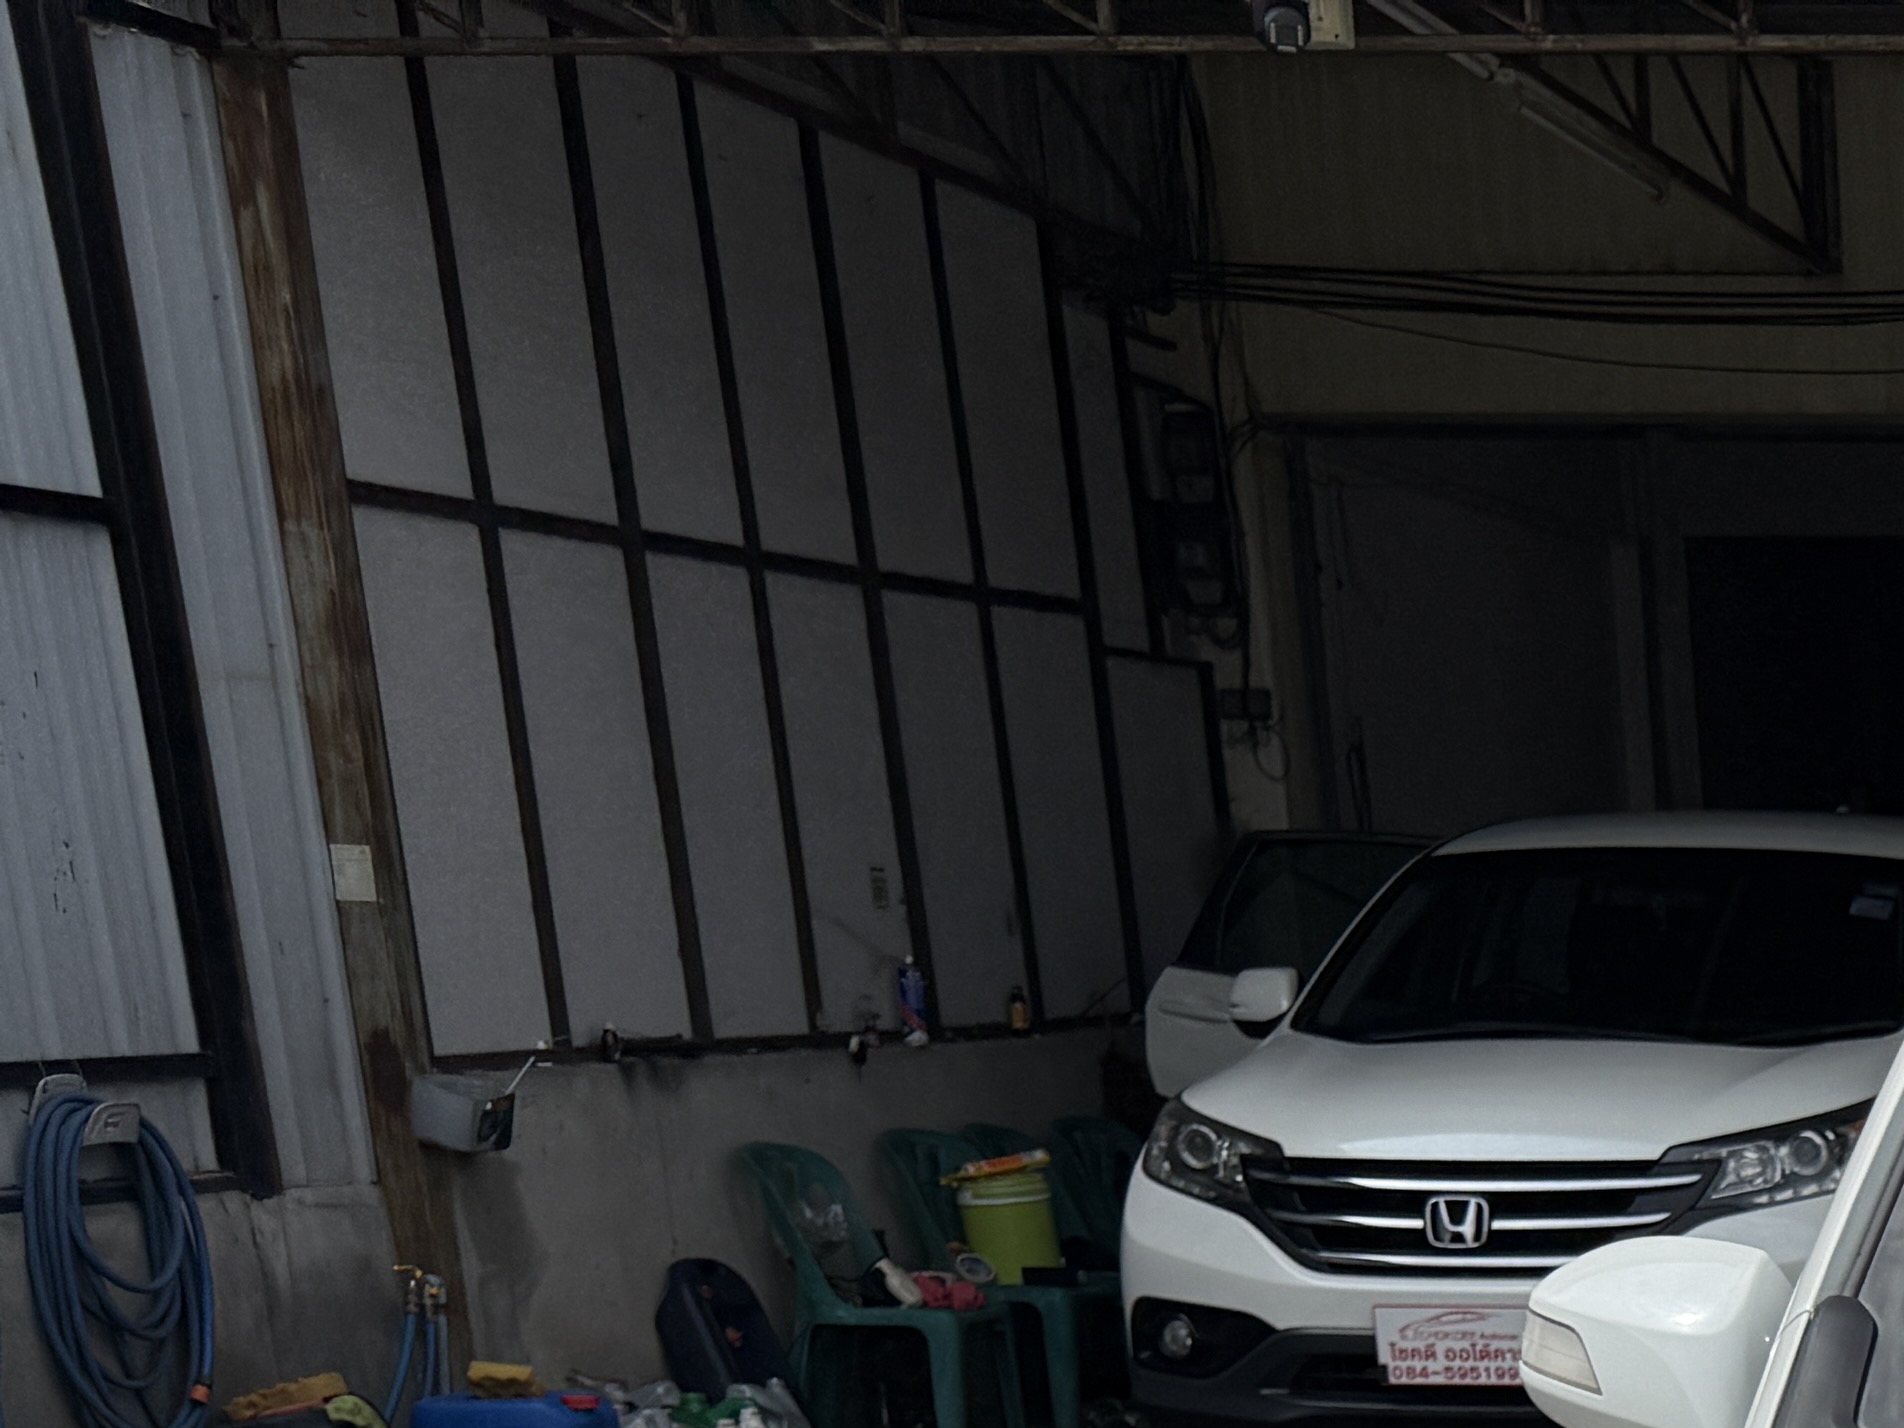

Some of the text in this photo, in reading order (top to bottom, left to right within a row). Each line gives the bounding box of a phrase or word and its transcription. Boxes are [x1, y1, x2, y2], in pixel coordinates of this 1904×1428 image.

[1444, 1342, 1521, 1362] ออโต้คา
[1392, 1365, 1520, 1380] 084-595199
